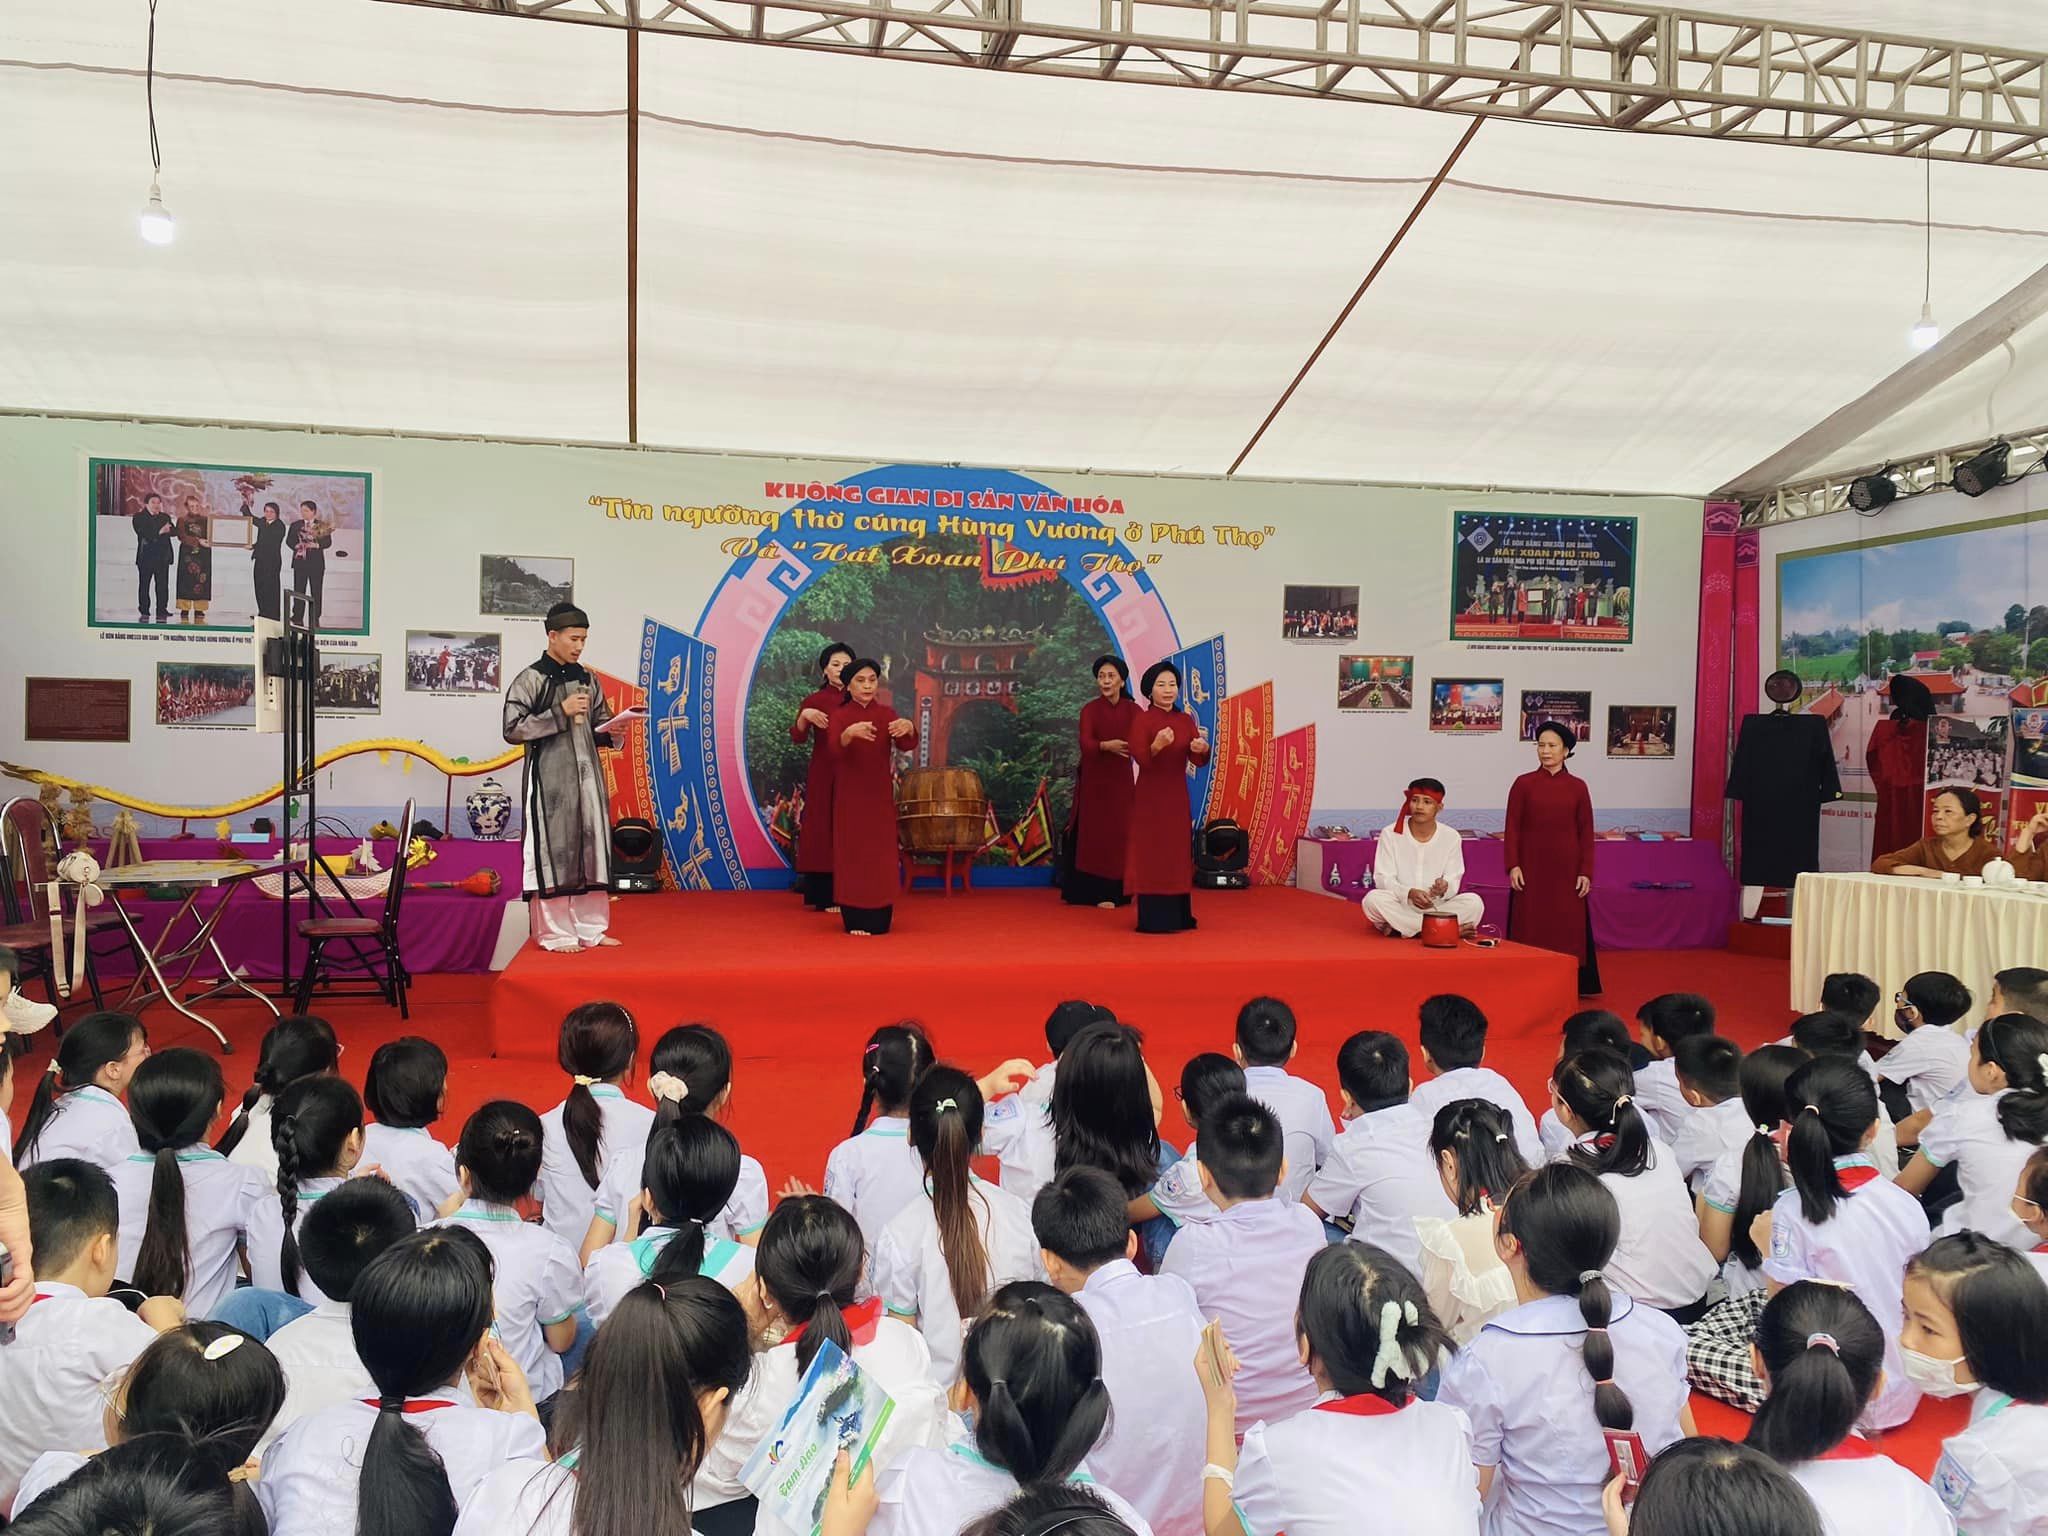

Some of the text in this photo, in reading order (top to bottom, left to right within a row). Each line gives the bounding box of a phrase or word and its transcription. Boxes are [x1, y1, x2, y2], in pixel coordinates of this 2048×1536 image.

[764, 481, 1126, 515] KHÔNG GIAN DI SẢN VĂN HÓA
[662, 504, 781, 532] ngưỡng
[792, 508, 845, 529] thờ
[854, 512, 927, 540] cúng
[937, 514, 1015, 543] Hùng
[1025, 518, 1117, 547] Vương
[1124, 521, 1143, 542] ở
[1151, 523, 1205, 545] Phú
[720, 537, 782, 559] Và
[891, 545, 982, 568] Xoan
[995, 549, 1067, 572] Phú
[1494, 547, 1515, 557] HÁT
[1520, 549, 1550, 558] XOAN
[1553, 549, 1576, 559] PHÚ
